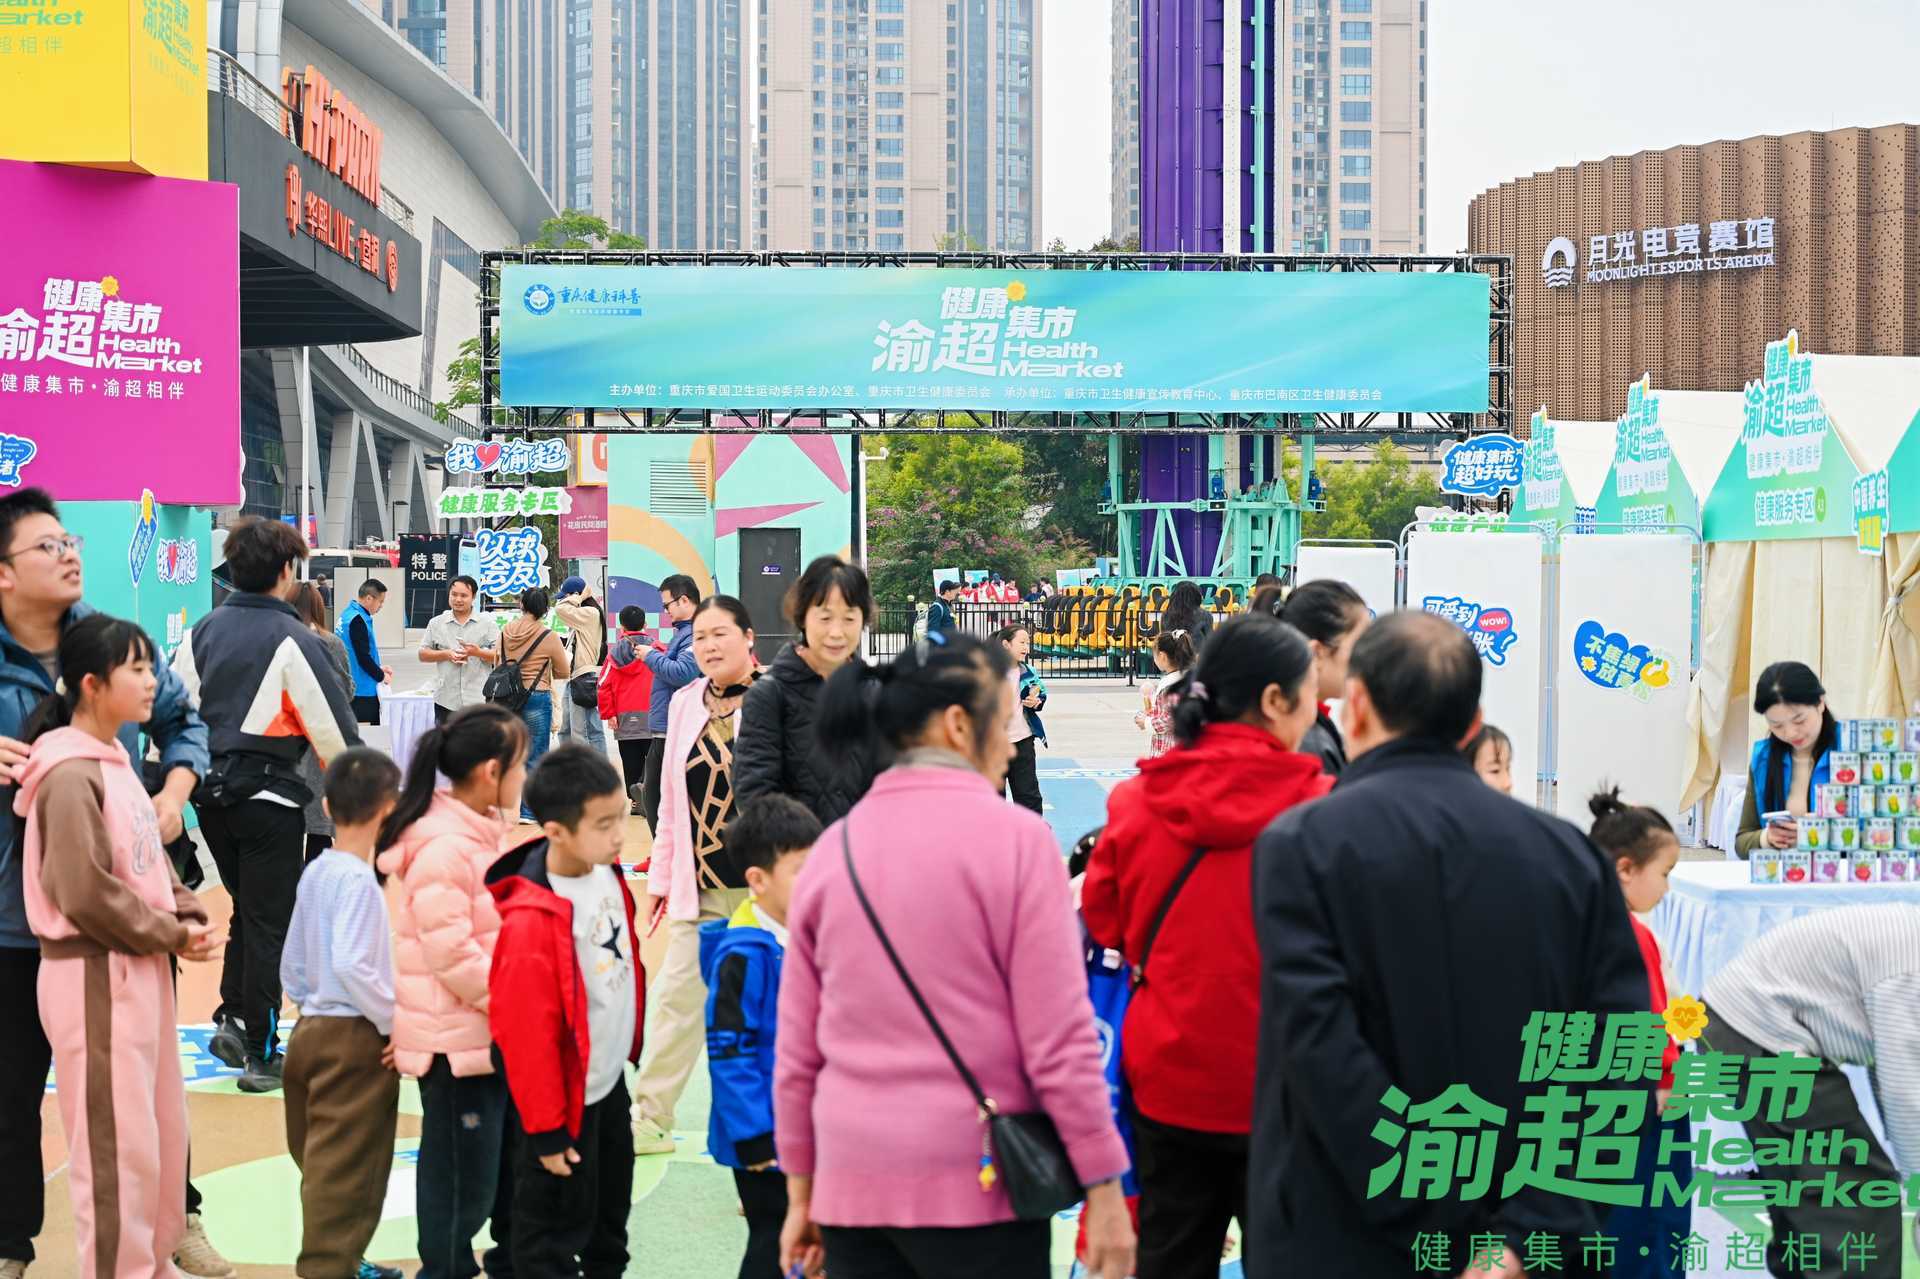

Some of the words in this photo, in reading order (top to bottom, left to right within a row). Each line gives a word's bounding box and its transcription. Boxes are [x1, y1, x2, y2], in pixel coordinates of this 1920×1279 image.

[0, 10, 83, 25] arket
[1588, 217, 1775, 266] 月光电竞赛馆
[1724, 253, 1775, 269] ARENA
[43, 278, 104, 312] 健康
[939, 287, 1008, 320] 健康
[100, 300, 162, 334] 集市
[1004, 305, 1077, 339] 集市
[98, 334, 181, 355] Health
[871, 319, 999, 377] 渝超
[1003, 341, 1098, 359] Health
[95, 353, 203, 374] Market
[999, 360, 1124, 378] Market
[1743, 382, 1785, 439] 渝超
[1787, 395, 1819, 416] Health
[1785, 416, 1828, 436] Market
[439, 491, 560, 514] 健康服务专区
[411, 553, 447, 569] 特警
[411, 571, 447, 581] POLICE
